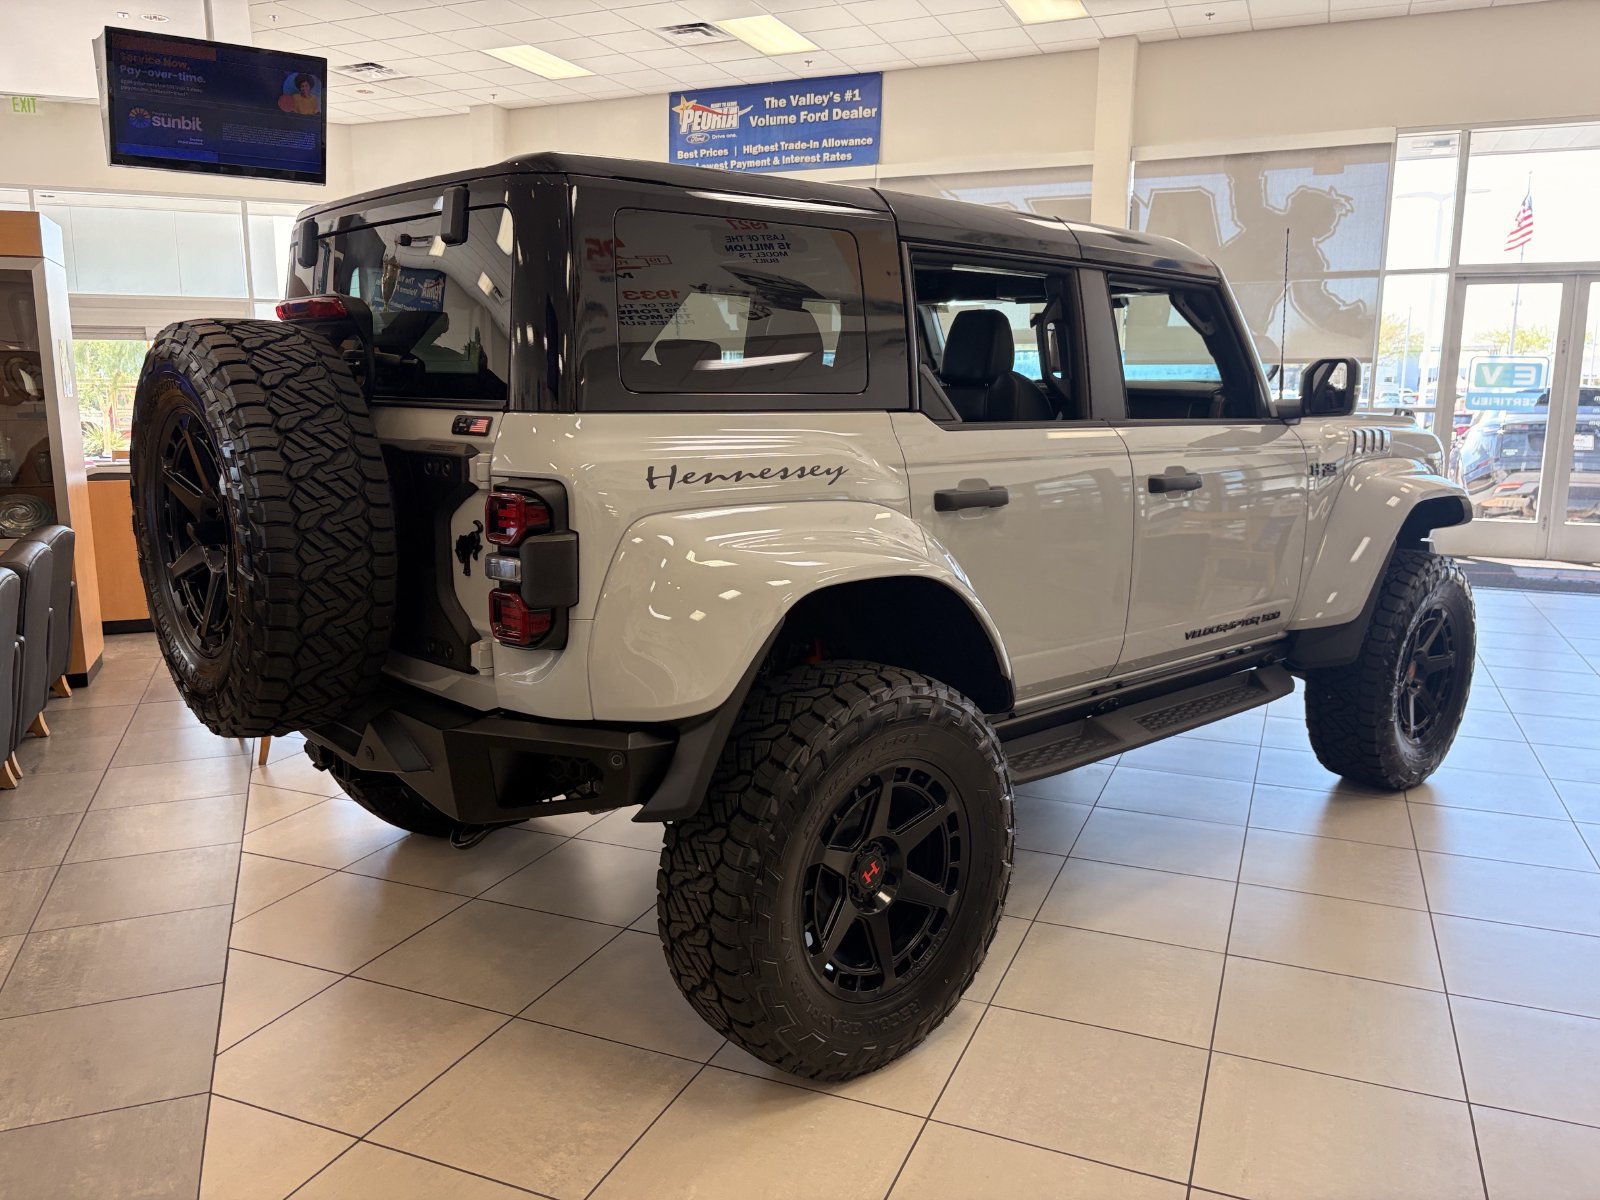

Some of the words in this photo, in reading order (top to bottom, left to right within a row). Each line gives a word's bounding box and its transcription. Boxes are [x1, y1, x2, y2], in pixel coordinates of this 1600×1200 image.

[119, 64, 206, 84] Pay-over-time.
[12, 96, 37, 113] EXIT
[764, 96, 787, 109] The
[790, 92, 841, 109] Valley's
[844, 89, 862, 102] #1
[151, 115, 203, 132] sunbit
[680, 106, 740, 135] PEORIA
[750, 114, 797, 128] Volume
[800, 109, 829, 124] Ford
[832, 106, 878, 121] Dealer
[677, 149, 698, 160] Best
[700, 147, 729, 158] Prices
[743, 143, 779, 156] Highest
[780, 140, 820, 152] Trade-In
[822, 136, 874, 149] Allowance
[730, 157, 771, 170] Payment
[772, 156, 780, 165] &
[782, 153, 821, 165] Interest
[823, 151, 853, 162] Rates
[646, 464, 849, 491] Hennessey
[1184, 616, 1261, 641] VELOCIRAPTOR
[1261, 610, 1281, 623] 500
